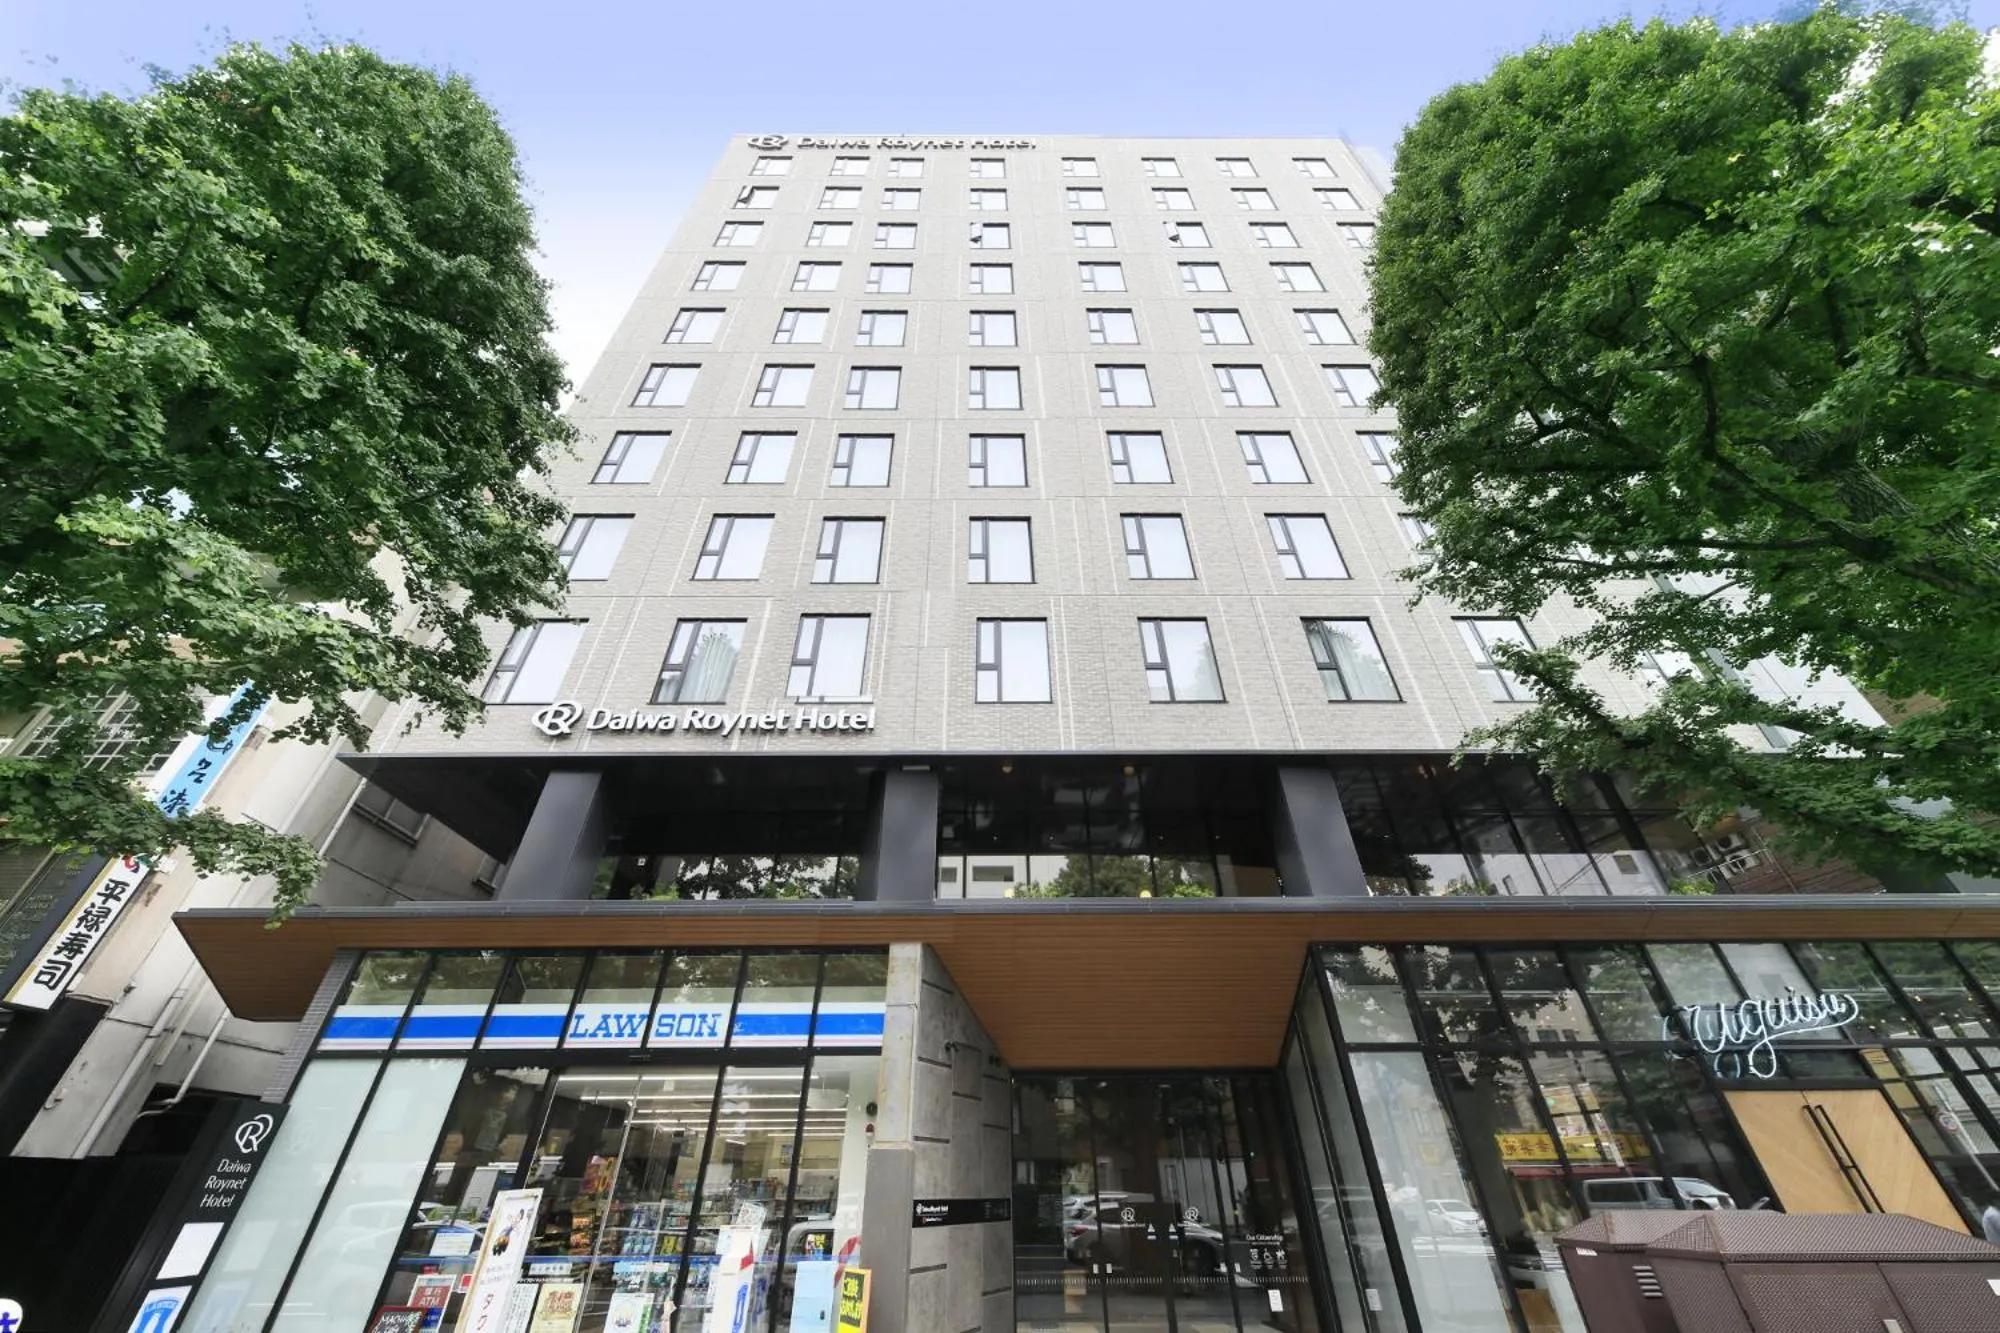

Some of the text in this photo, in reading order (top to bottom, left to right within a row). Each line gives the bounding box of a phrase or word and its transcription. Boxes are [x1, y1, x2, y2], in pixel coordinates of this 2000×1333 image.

[586, 706, 678, 732] Daiwa
[681, 706, 790, 737] Roynet
[794, 706, 876, 732] Hotel
[33, 877, 130, 991] 平禄寿司
[569, 1013, 722, 1039] LAWSON
[1682, 986, 1859, 1079] Uguisu
[216, 1158, 252, 1173] Daiwa
[204, 1175, 247, 1192] Roynet
[200, 1193, 235, 1208] Hotel
